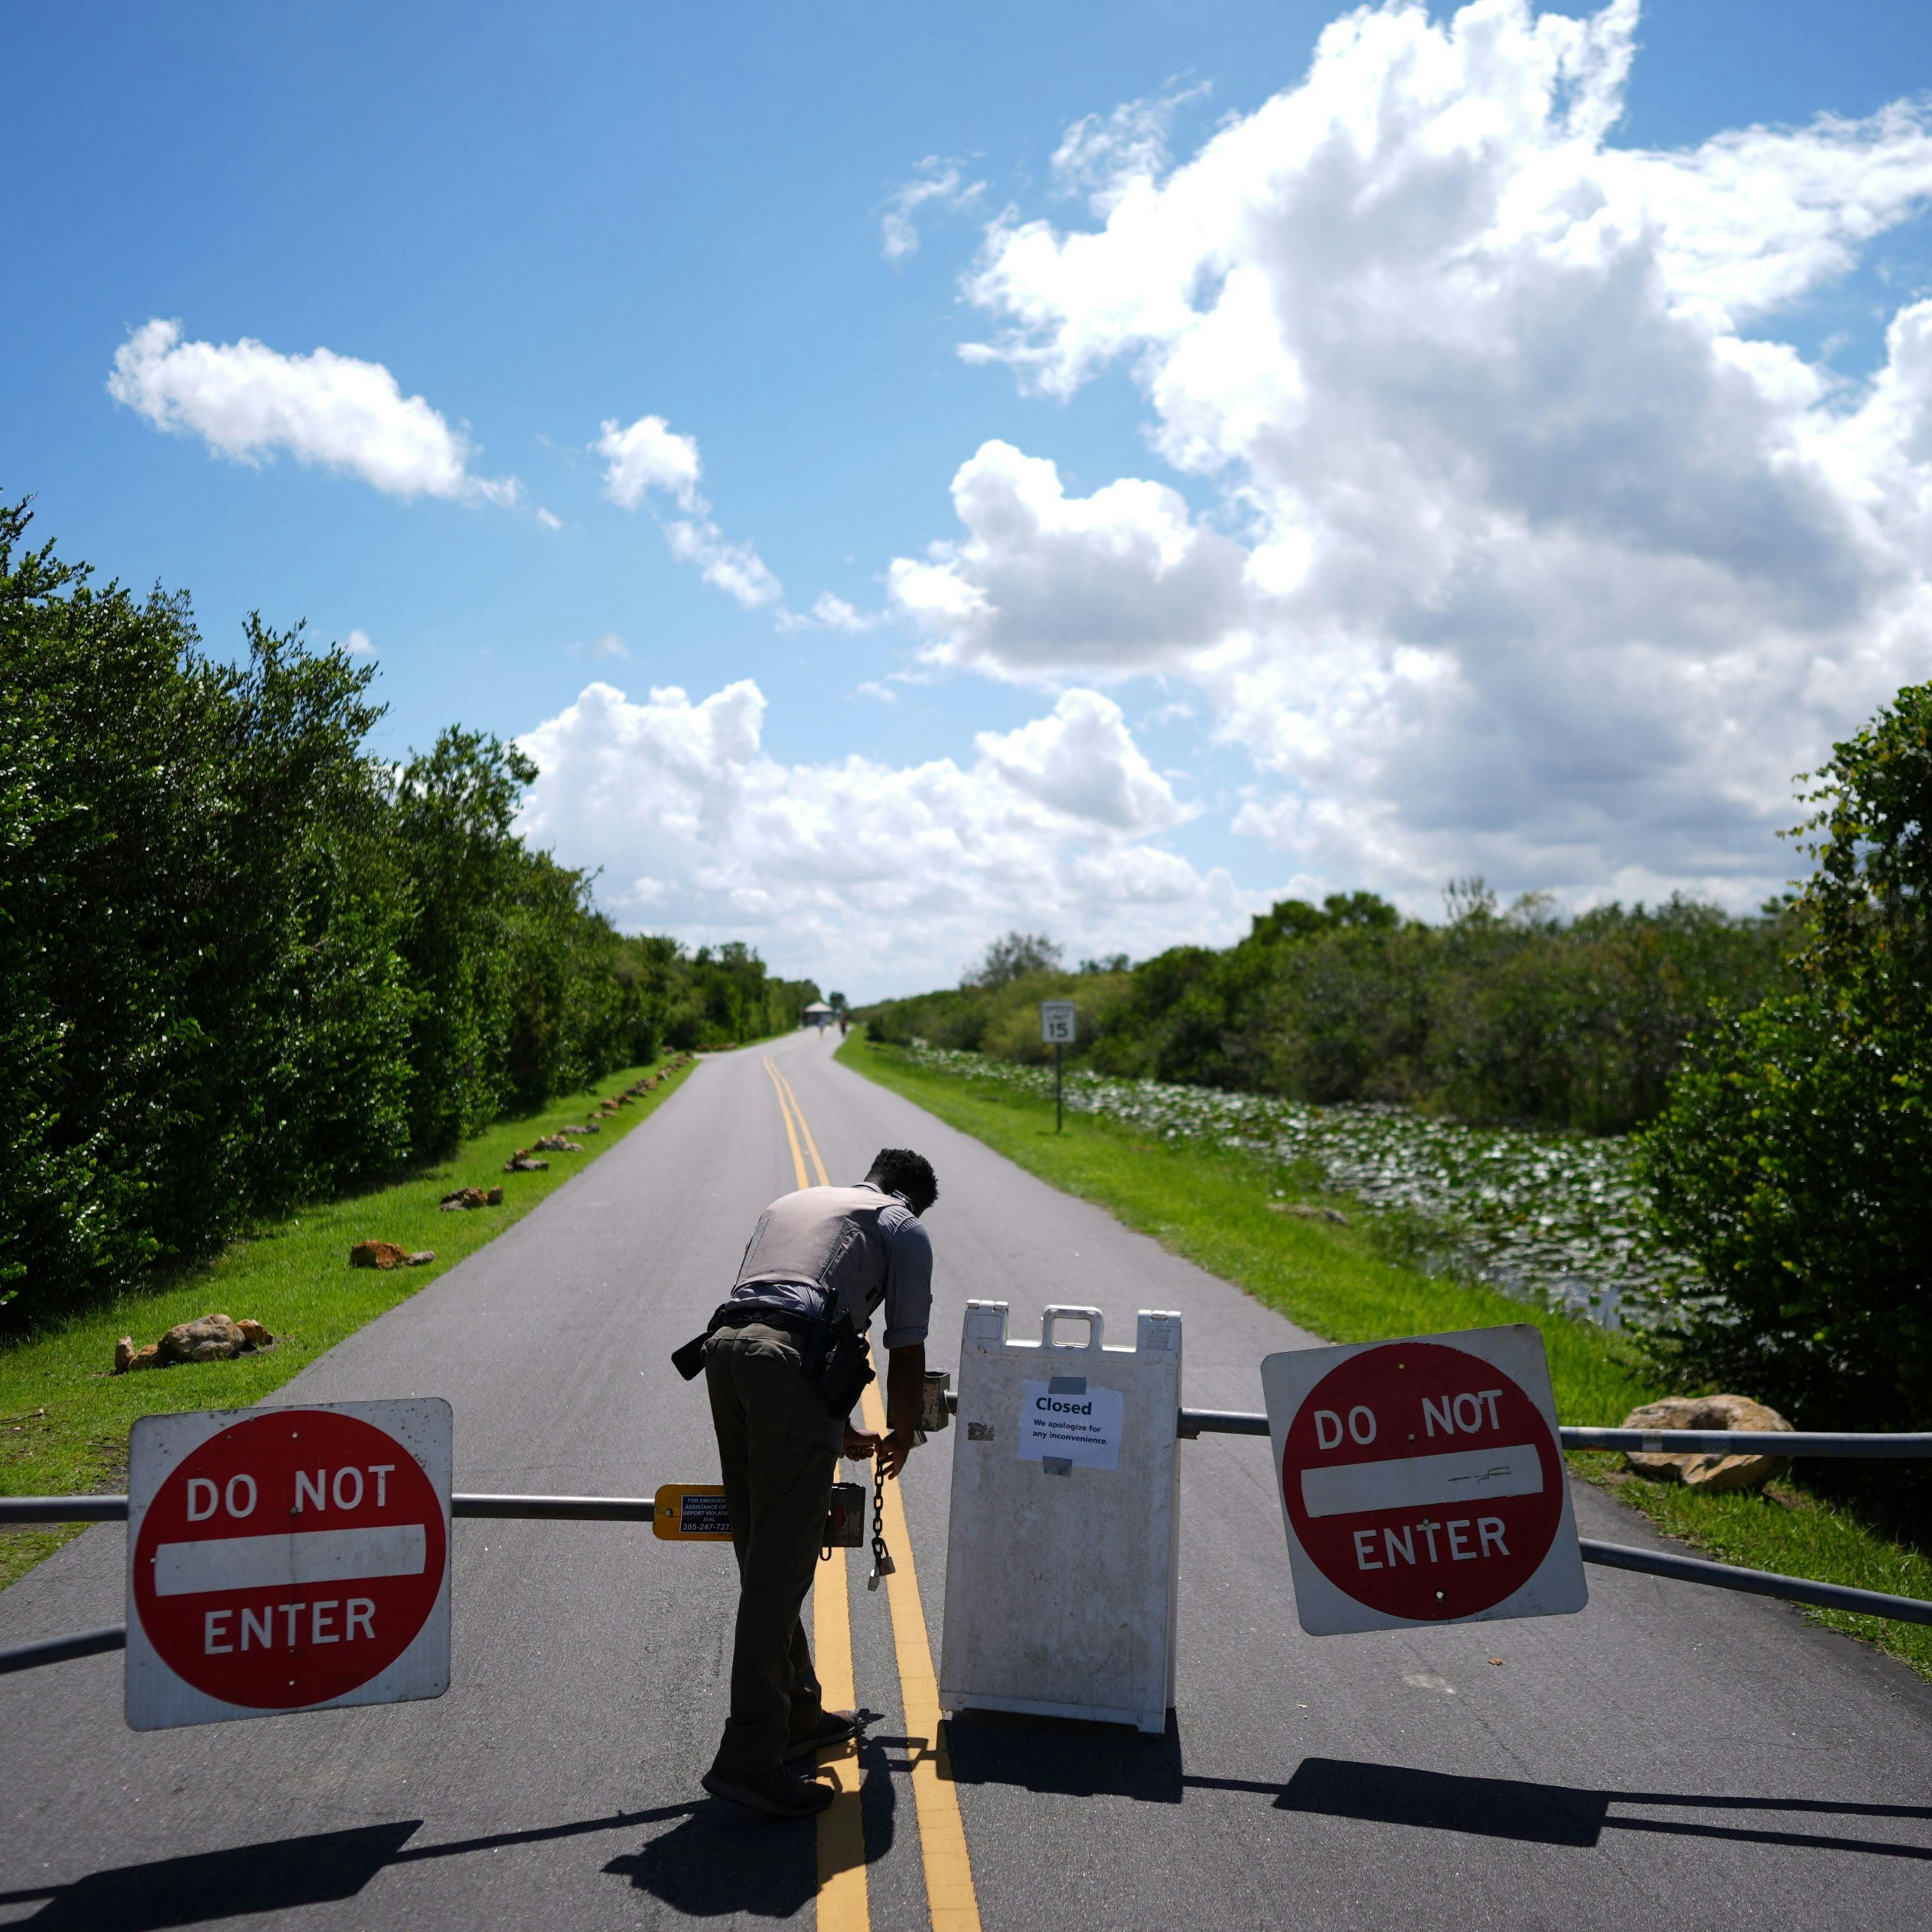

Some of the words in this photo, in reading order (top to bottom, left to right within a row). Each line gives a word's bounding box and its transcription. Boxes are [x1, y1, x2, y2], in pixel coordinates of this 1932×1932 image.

[1049, 1023, 1068, 1037] 15
[1036, 1397, 1092, 1416] Closed
[1314, 1405, 1377, 1450] DO
[1421, 1389, 1502, 1437] NOT
[1032, 1430, 1047, 1439] any
[1049, 1432, 1108, 1445] inconvenience.
[1048, 1421, 1087, 1432] apologize
[1089, 1425, 1102, 1433] for
[187, 1474, 257, 1522] DO
[295, 1464, 395, 1513] NOT
[1353, 1517, 1510, 1571] ENTER
[204, 1598, 376, 1655] ENTER
